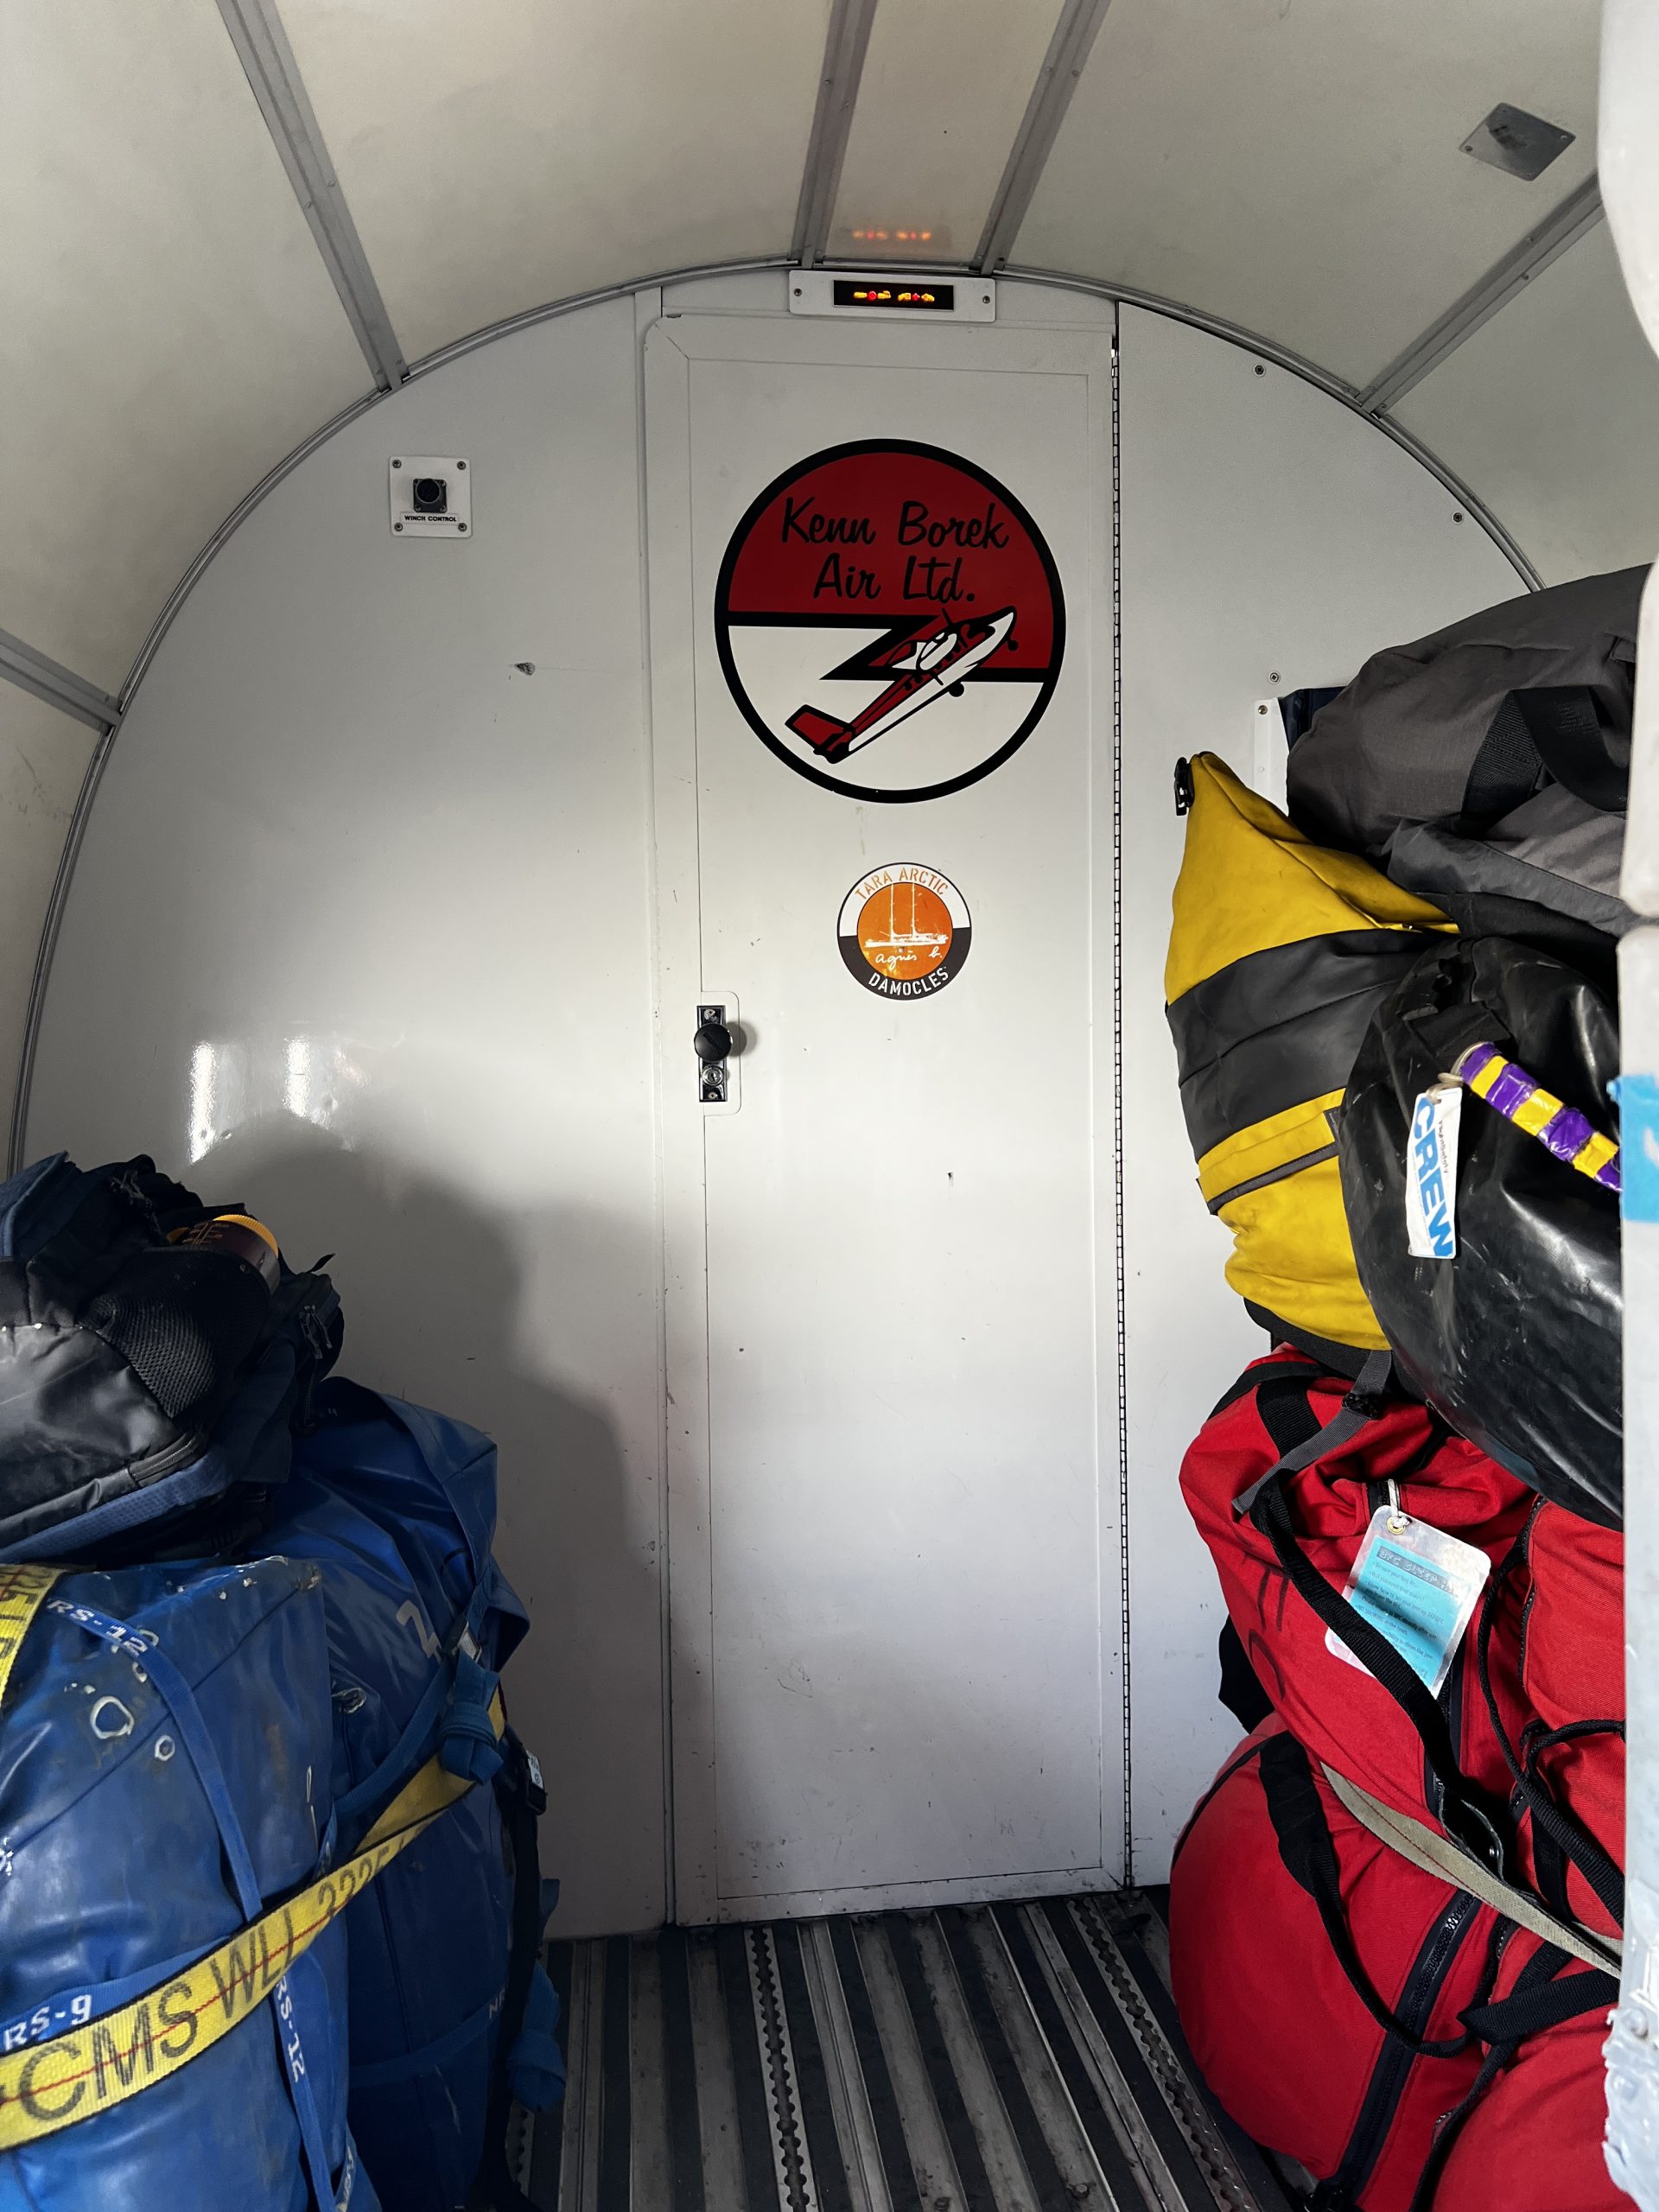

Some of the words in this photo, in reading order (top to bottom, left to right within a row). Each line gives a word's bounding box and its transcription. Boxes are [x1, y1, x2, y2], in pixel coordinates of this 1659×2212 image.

[781, 497, 876, 544] Kenn
[898, 500, 1009, 550] Borek
[813, 553, 881, 599] Air
[902, 556, 976, 603] Ltd.
[855, 870, 893, 899] TARA
[899, 867, 949, 895] ARCTIC
[868, 967, 949, 996] DAMOCLES
[1414, 1096, 1454, 1256] CREW
[47, 1599, 148, 1656] RS-12
[4, 1994, 92, 2050] RS-9
[18, 1981, 199, 2122] CMS
